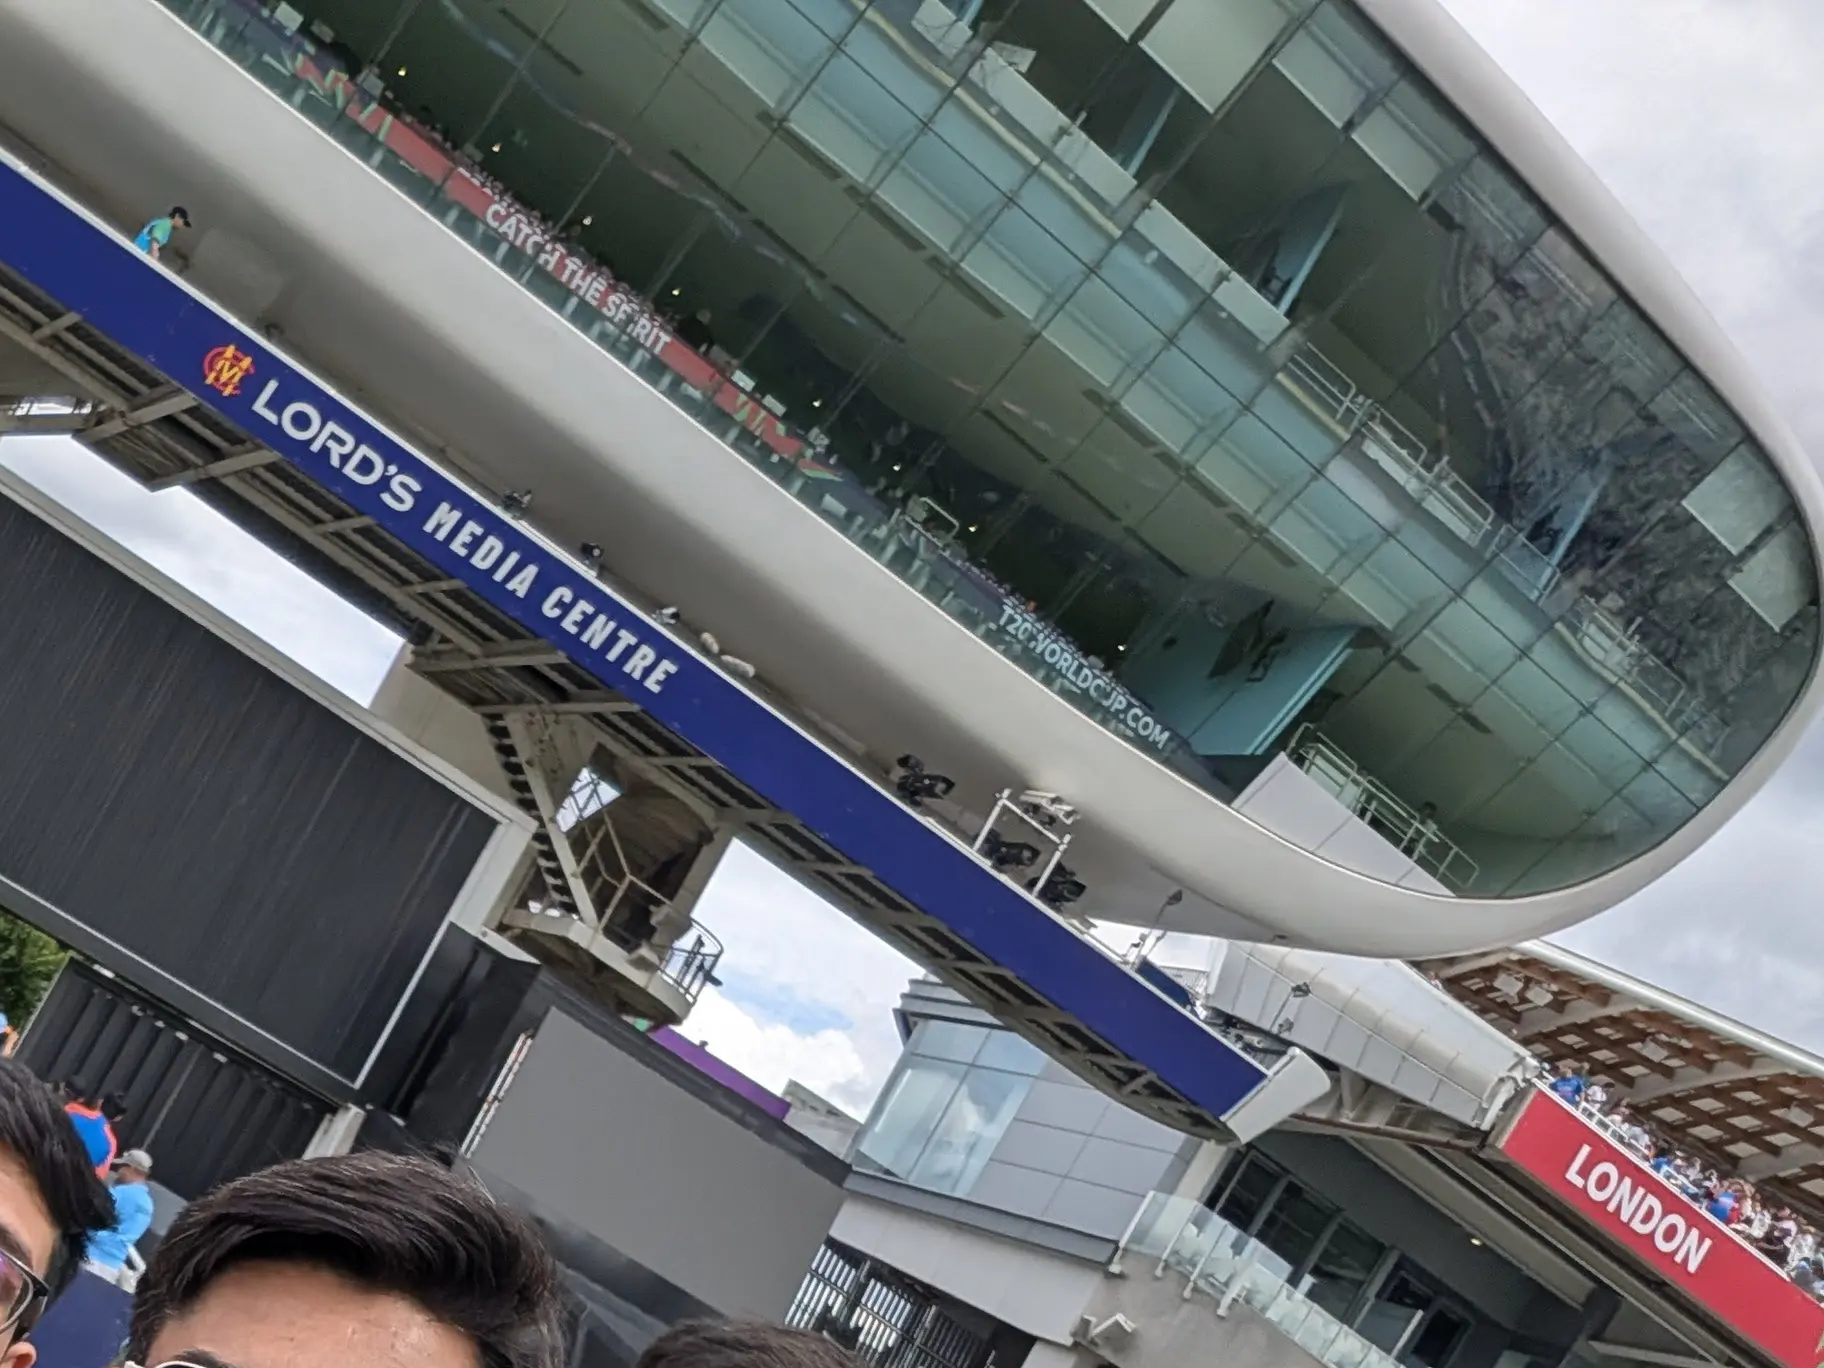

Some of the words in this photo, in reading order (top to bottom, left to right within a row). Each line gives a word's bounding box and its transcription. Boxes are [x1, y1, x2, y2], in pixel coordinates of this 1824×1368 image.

[560, 257, 605, 306] THE
[250, 378, 423, 512] LORD'S
[422, 500, 539, 599] MEDIA
[541, 585, 679, 695] CENTRE
[1564, 1144, 1713, 1274] LONDON
